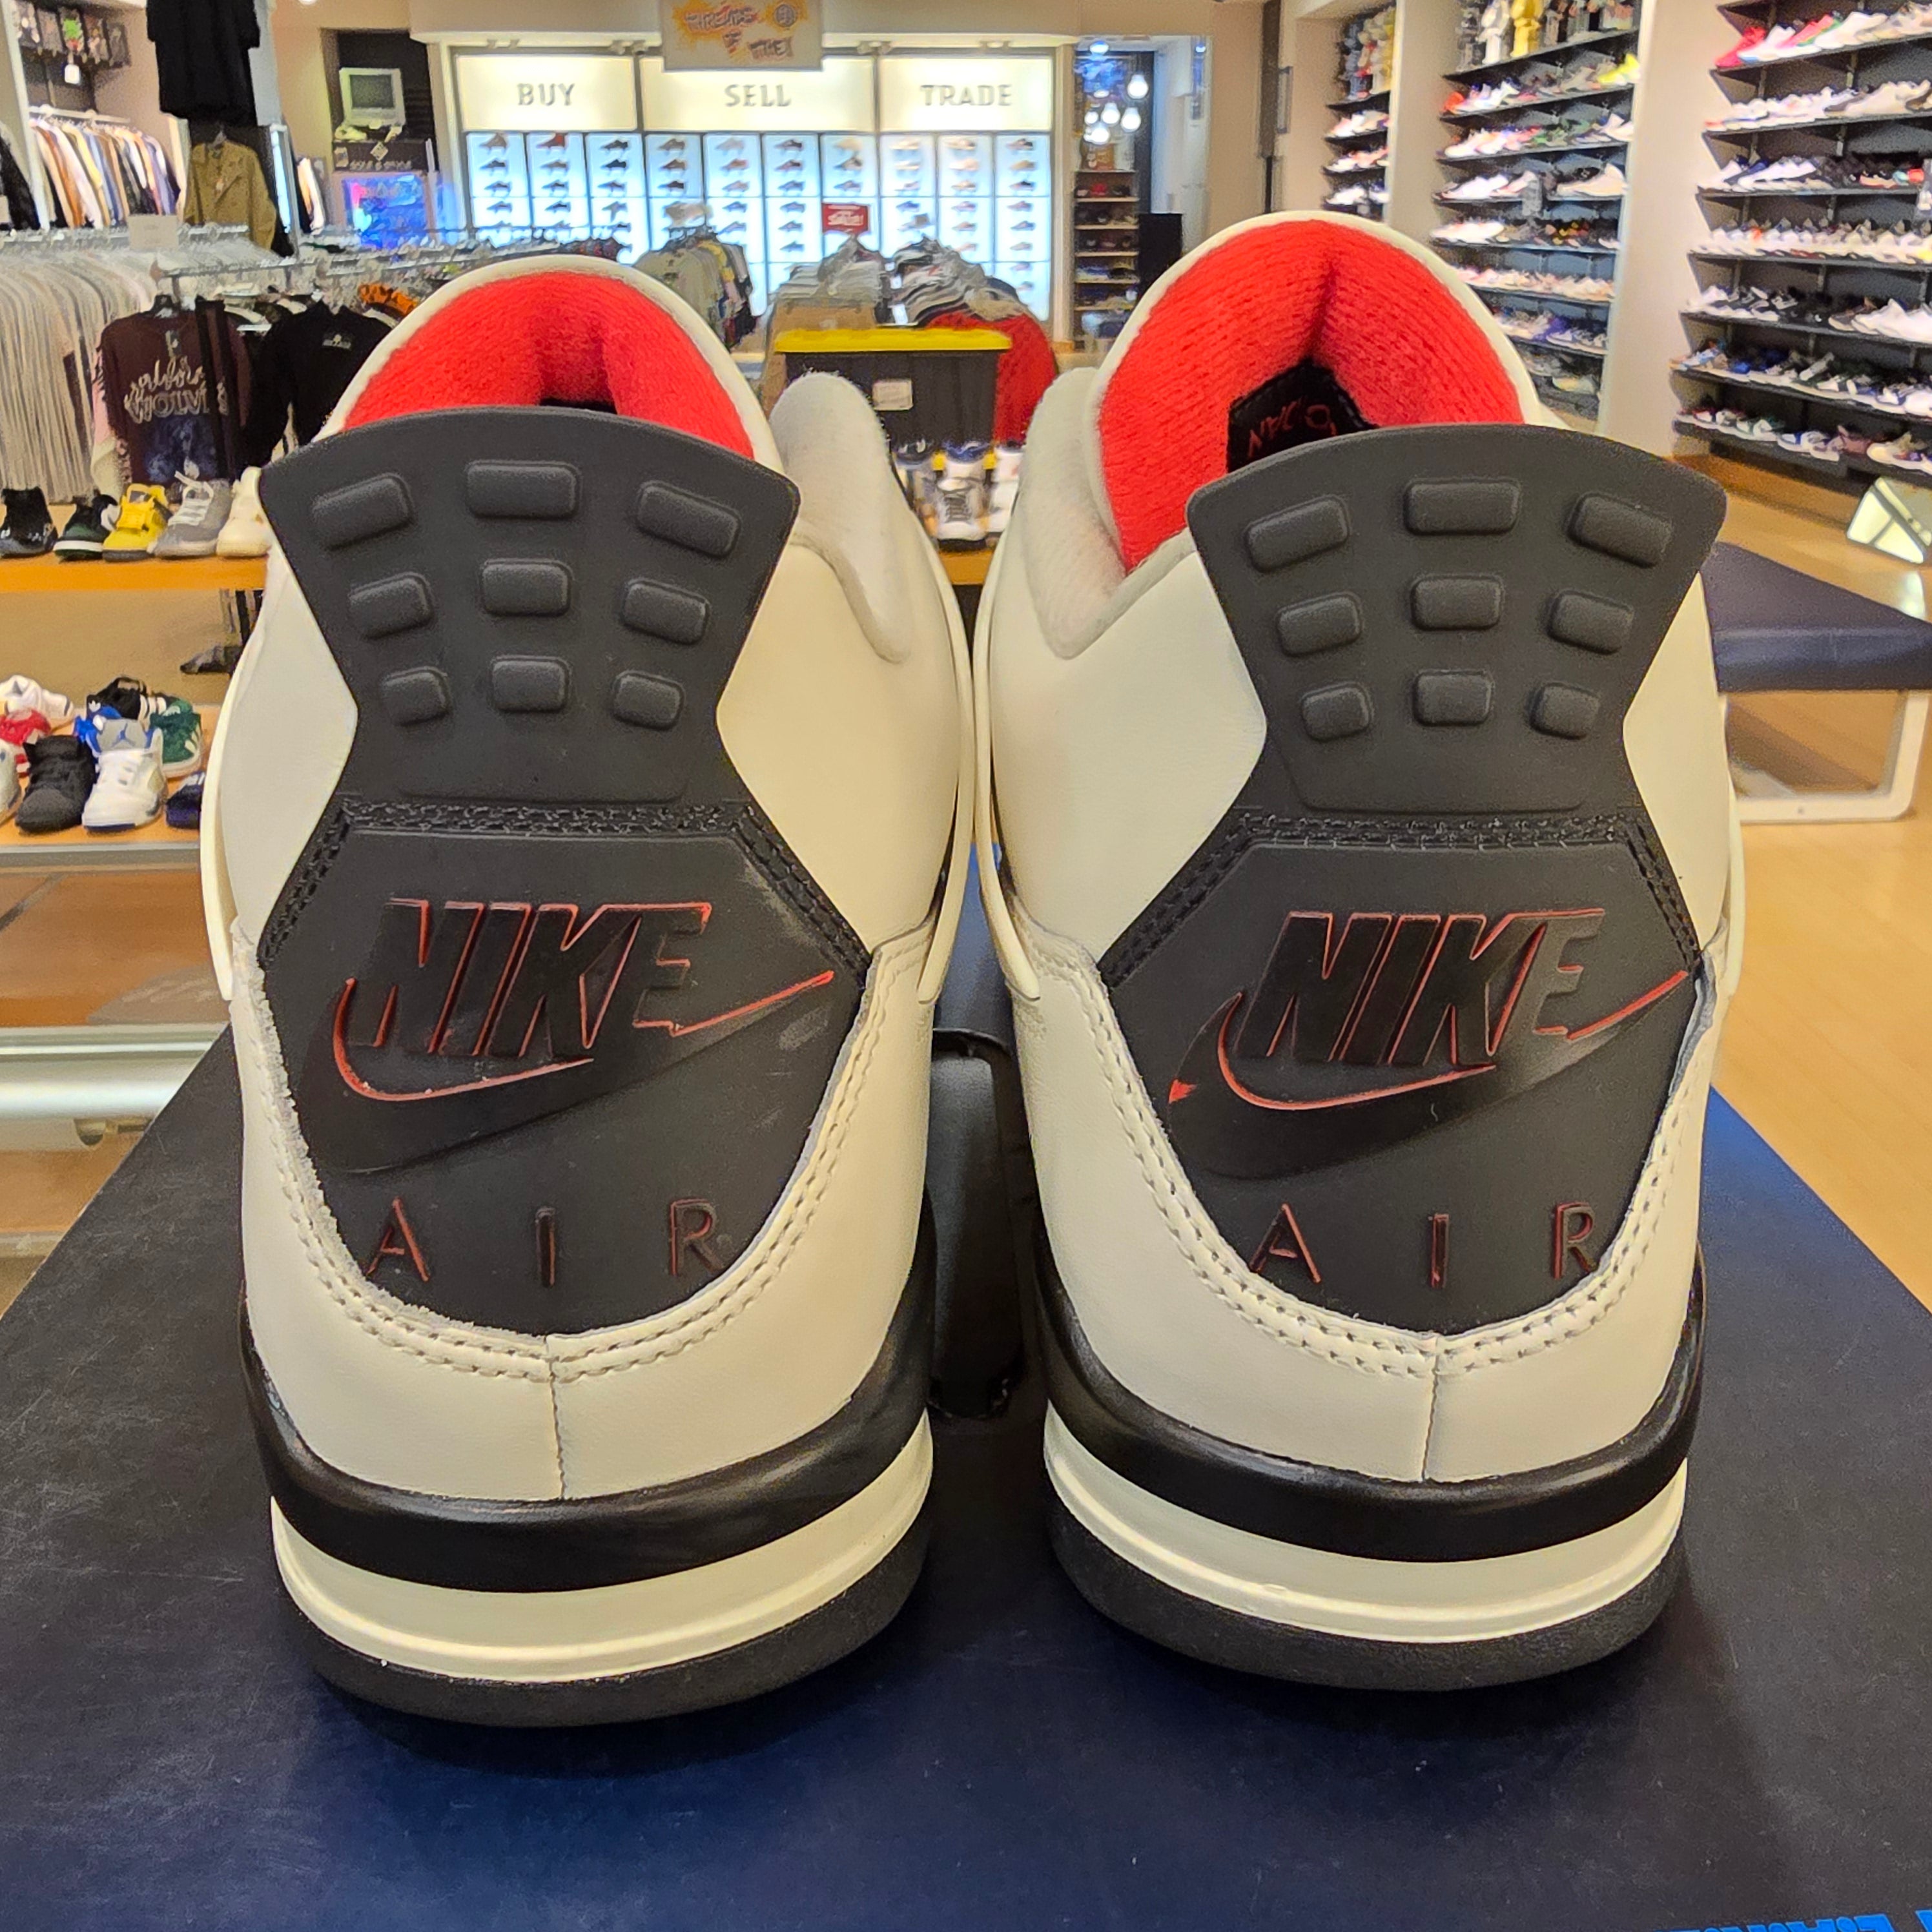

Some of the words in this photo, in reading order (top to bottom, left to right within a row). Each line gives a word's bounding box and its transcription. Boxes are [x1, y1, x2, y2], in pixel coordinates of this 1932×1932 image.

[517, 83, 575, 106] BUY
[724, 84, 792, 107] SELL
[920, 84, 1012, 106] TRADE
[351, 898, 712, 1059] NIKE
[1233, 909, 1605, 1065] NIKE
[365, 1197, 732, 1288] AIR
[1249, 1202, 1599, 1288] AIR
